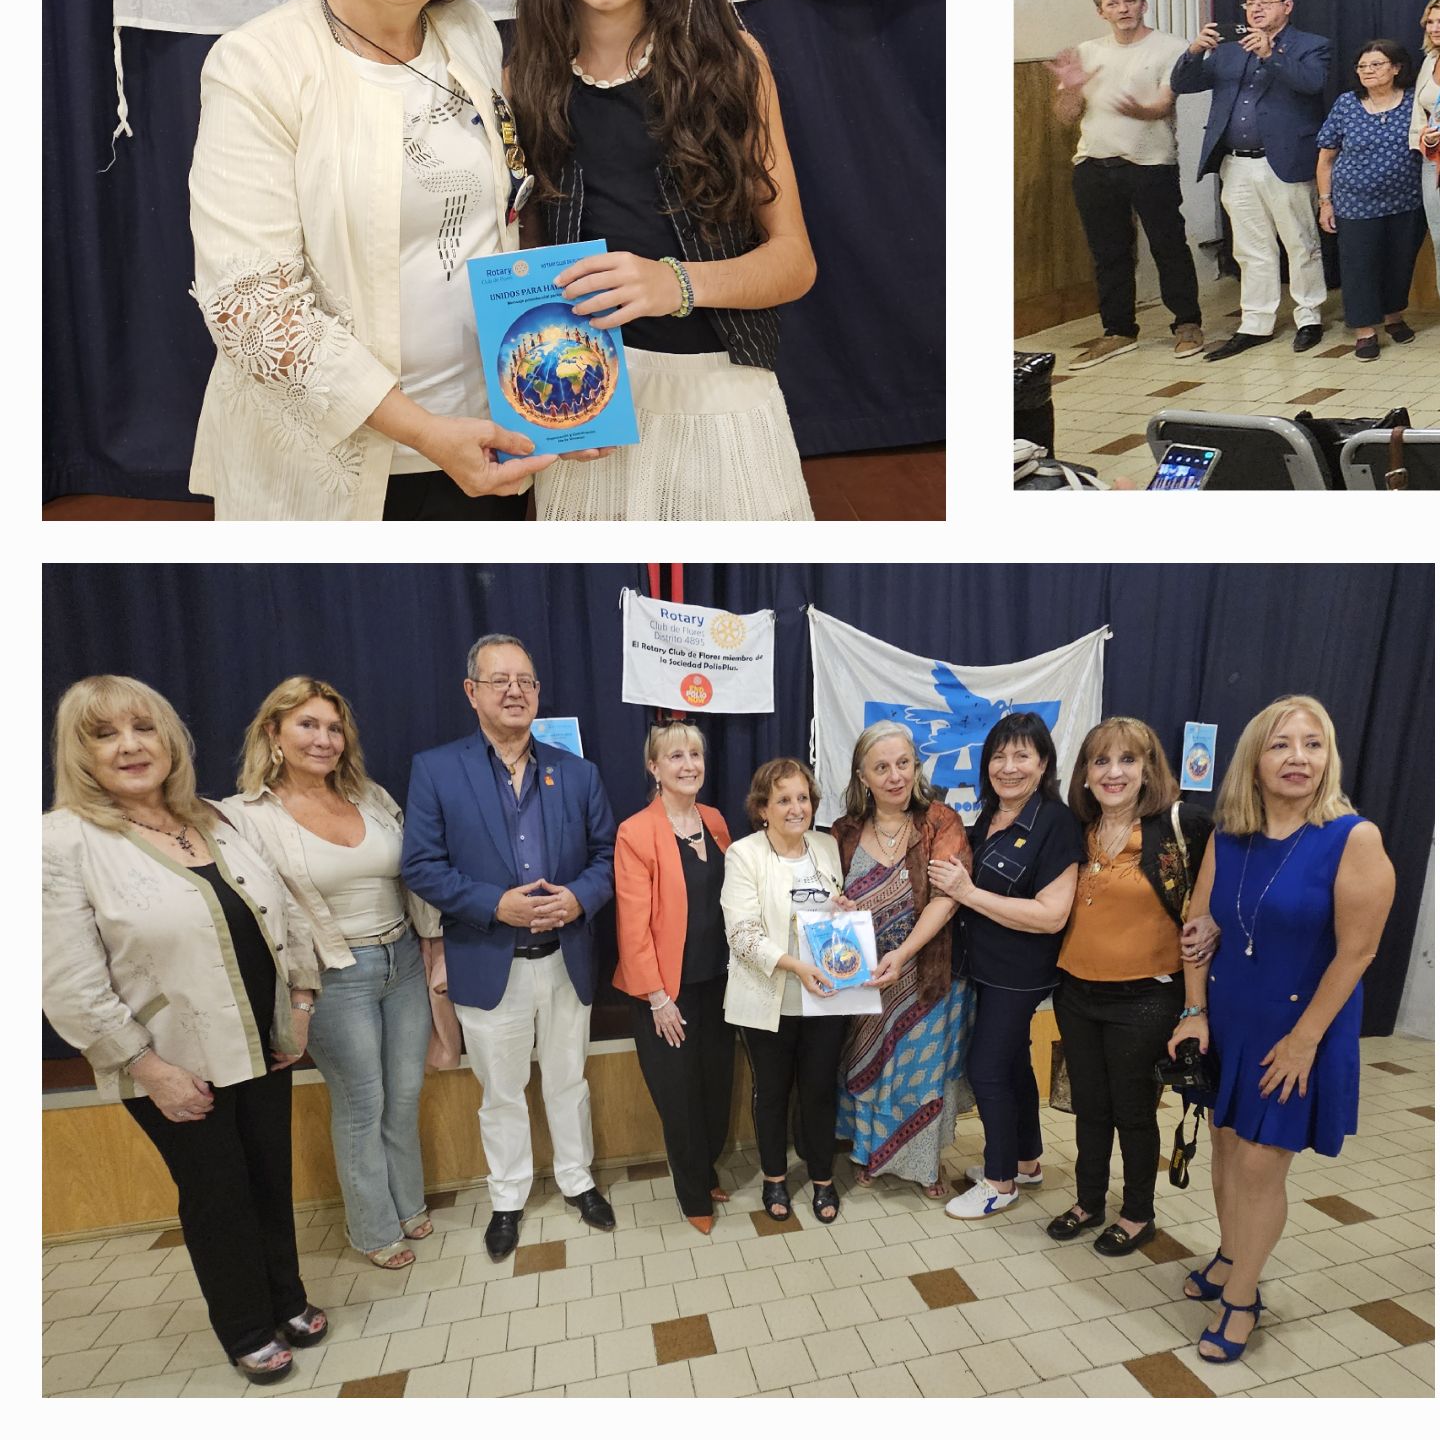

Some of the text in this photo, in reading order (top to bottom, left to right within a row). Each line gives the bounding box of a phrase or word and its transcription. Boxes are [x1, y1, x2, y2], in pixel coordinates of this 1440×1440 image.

[486, 268, 512, 277] Rotary
[490, 289, 520, 301] UNIDOS
[521, 286, 542, 296] PARA
[660, 608, 704, 627] Rotary
[650, 620, 704, 637] Club de Flores
[654, 632, 705, 646] Distrito 4895
[632, 640, 640, 648] El
[641, 642, 667, 654] Rotary
[668, 648, 686, 657] Club
[688, 650, 697, 658] de
[699, 651, 721, 661] Flores
[722, 653, 753, 662] miembro
[669, 658, 702, 669] Sociedad
